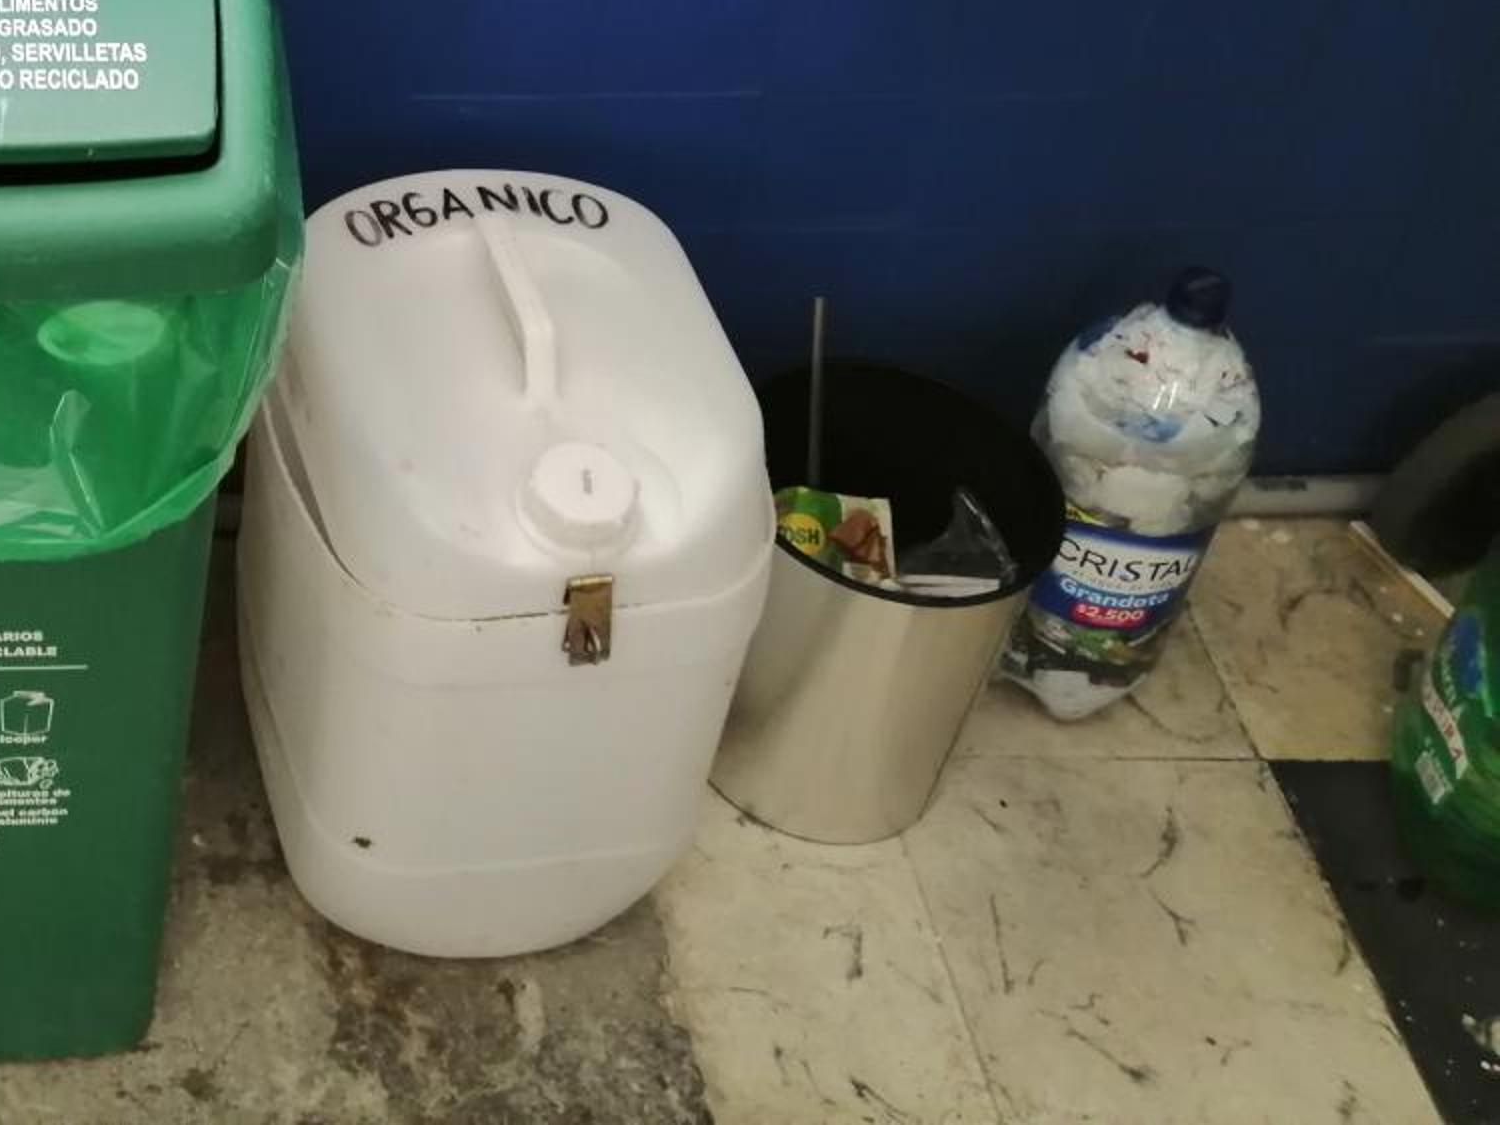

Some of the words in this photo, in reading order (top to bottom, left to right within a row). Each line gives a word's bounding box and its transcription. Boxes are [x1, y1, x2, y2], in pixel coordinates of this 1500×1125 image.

[11, 43, 148, 63] SERVILLETAS
[20, 69, 140, 89] RECICLADO
[344, 183, 609, 247] ORGANICO
[53, 788, 71, 799] de
